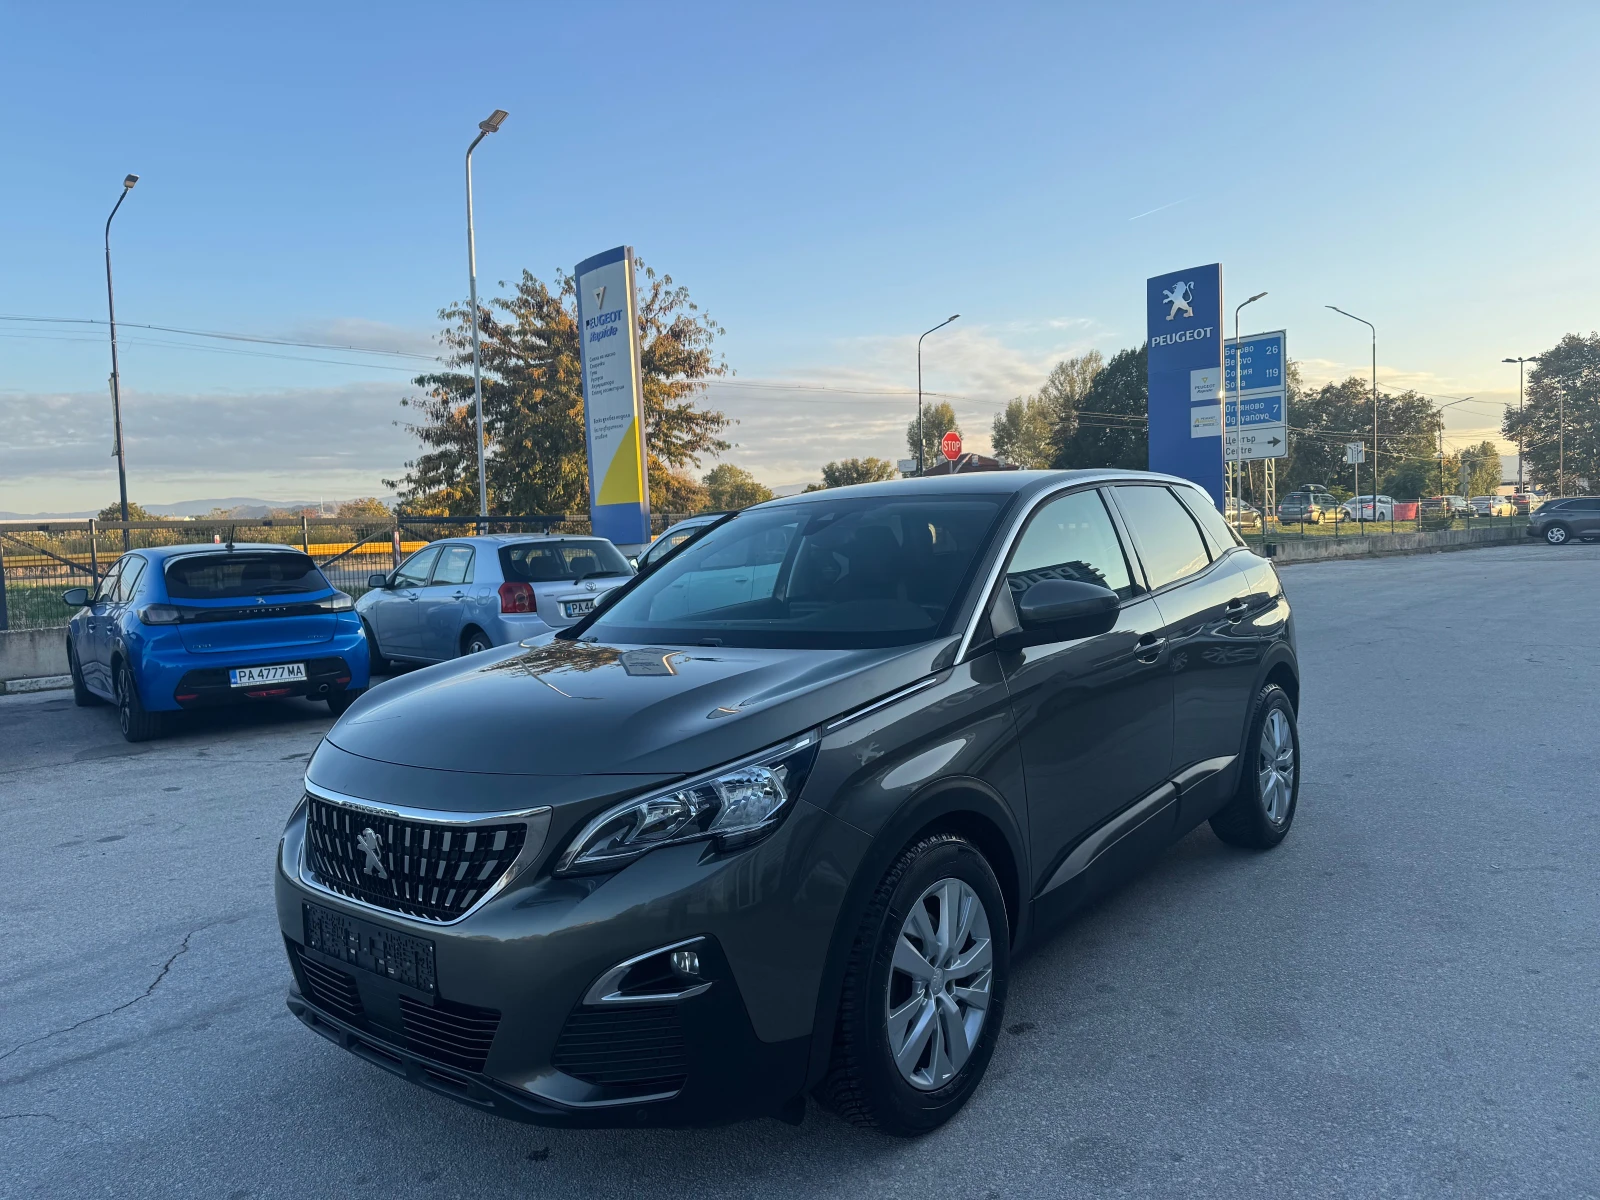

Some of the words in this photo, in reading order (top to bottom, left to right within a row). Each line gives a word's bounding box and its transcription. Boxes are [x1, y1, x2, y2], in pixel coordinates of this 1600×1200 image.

[586, 309, 623, 330] PEUGEOT
[1151, 326, 1214, 348] PEUGEOT
[1225, 346, 1254, 356] Беово
[1265, 345, 1279, 355] 26
[1265, 368, 1279, 378] 119
[1272, 404, 1279, 413] 7
[1225, 412, 1270, 425] Ogyanovo
[943, 440, 961, 452] STOP
[1225, 435, 1256, 446] Цетър
[238, 669, 256, 682] PA
[257, 666, 286, 680] 4777
[287, 665, 304, 677] MA
